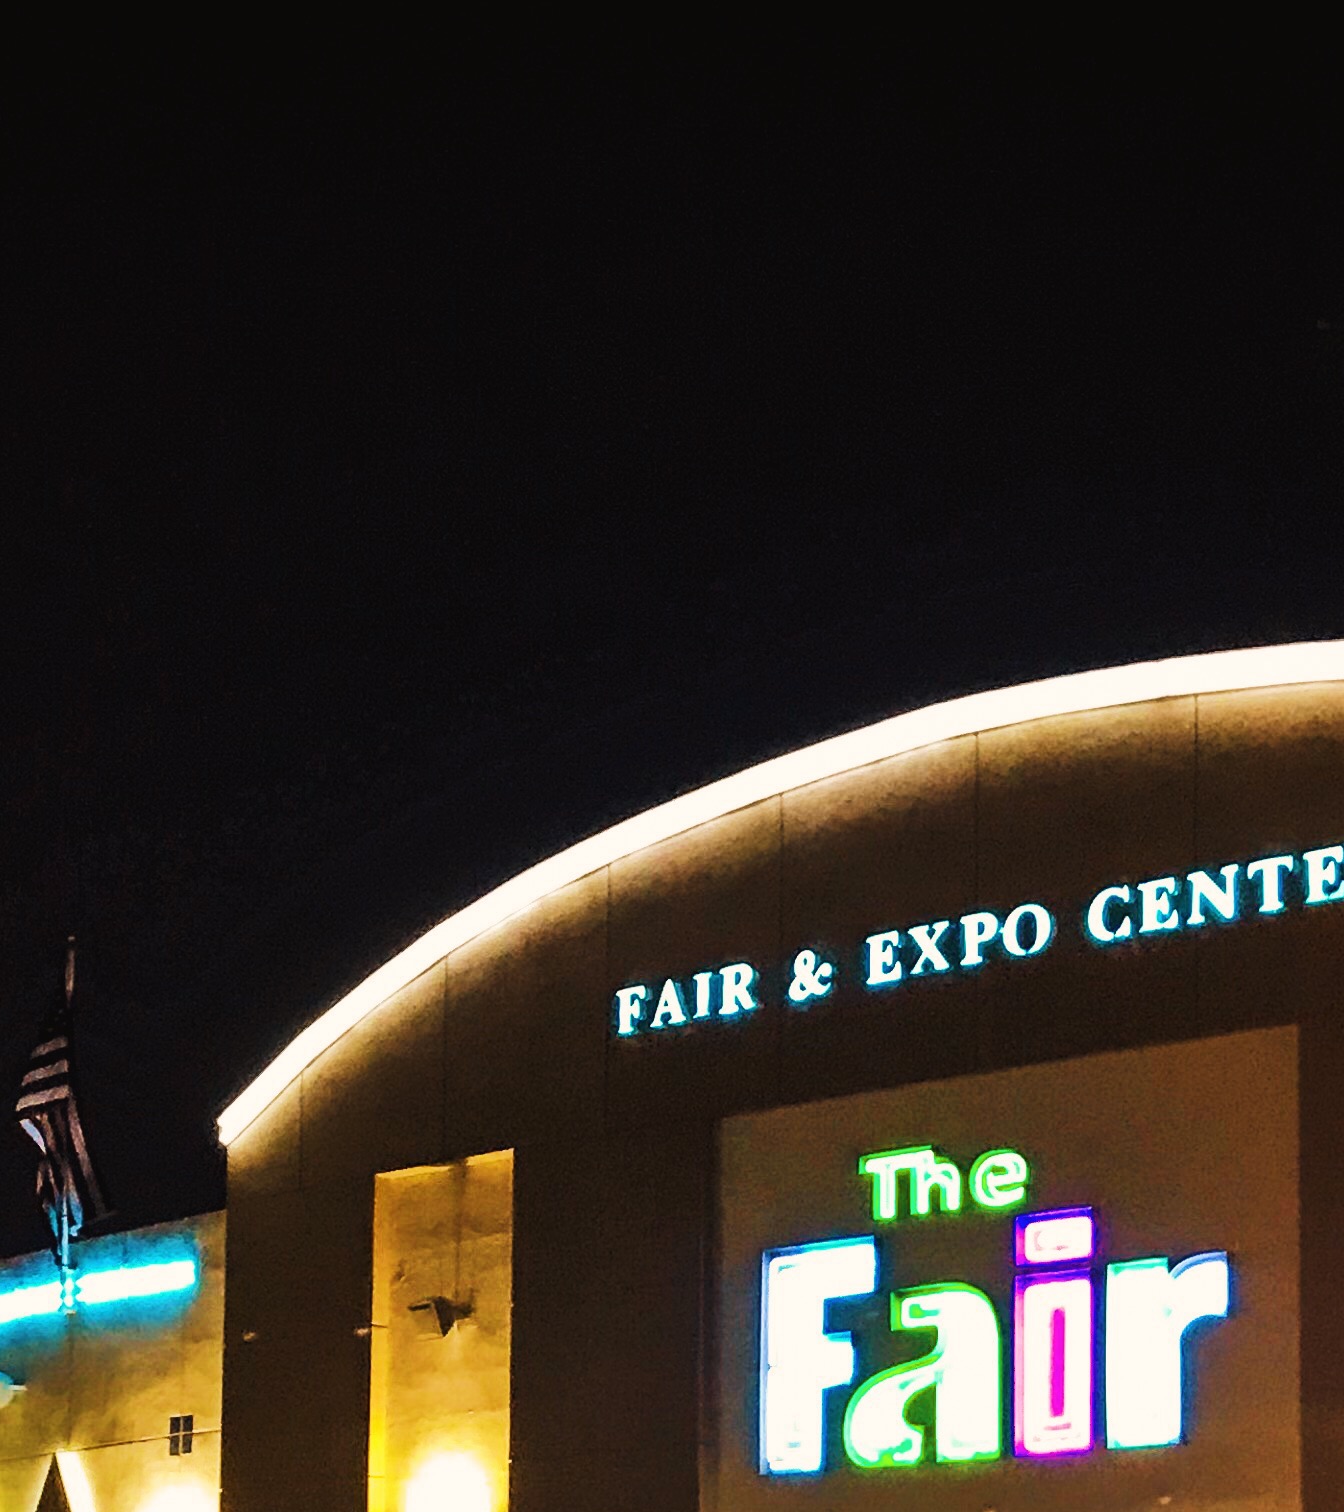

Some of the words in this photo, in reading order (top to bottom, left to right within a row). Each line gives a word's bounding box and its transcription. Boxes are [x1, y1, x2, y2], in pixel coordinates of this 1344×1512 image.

[616, 963, 757, 1036] FAIR
[789, 950, 832, 1002] &
[866, 904, 1052, 987] EXPO
[859, 1145, 1029, 1222] The
[759, 1206, 1231, 1476] Fair
